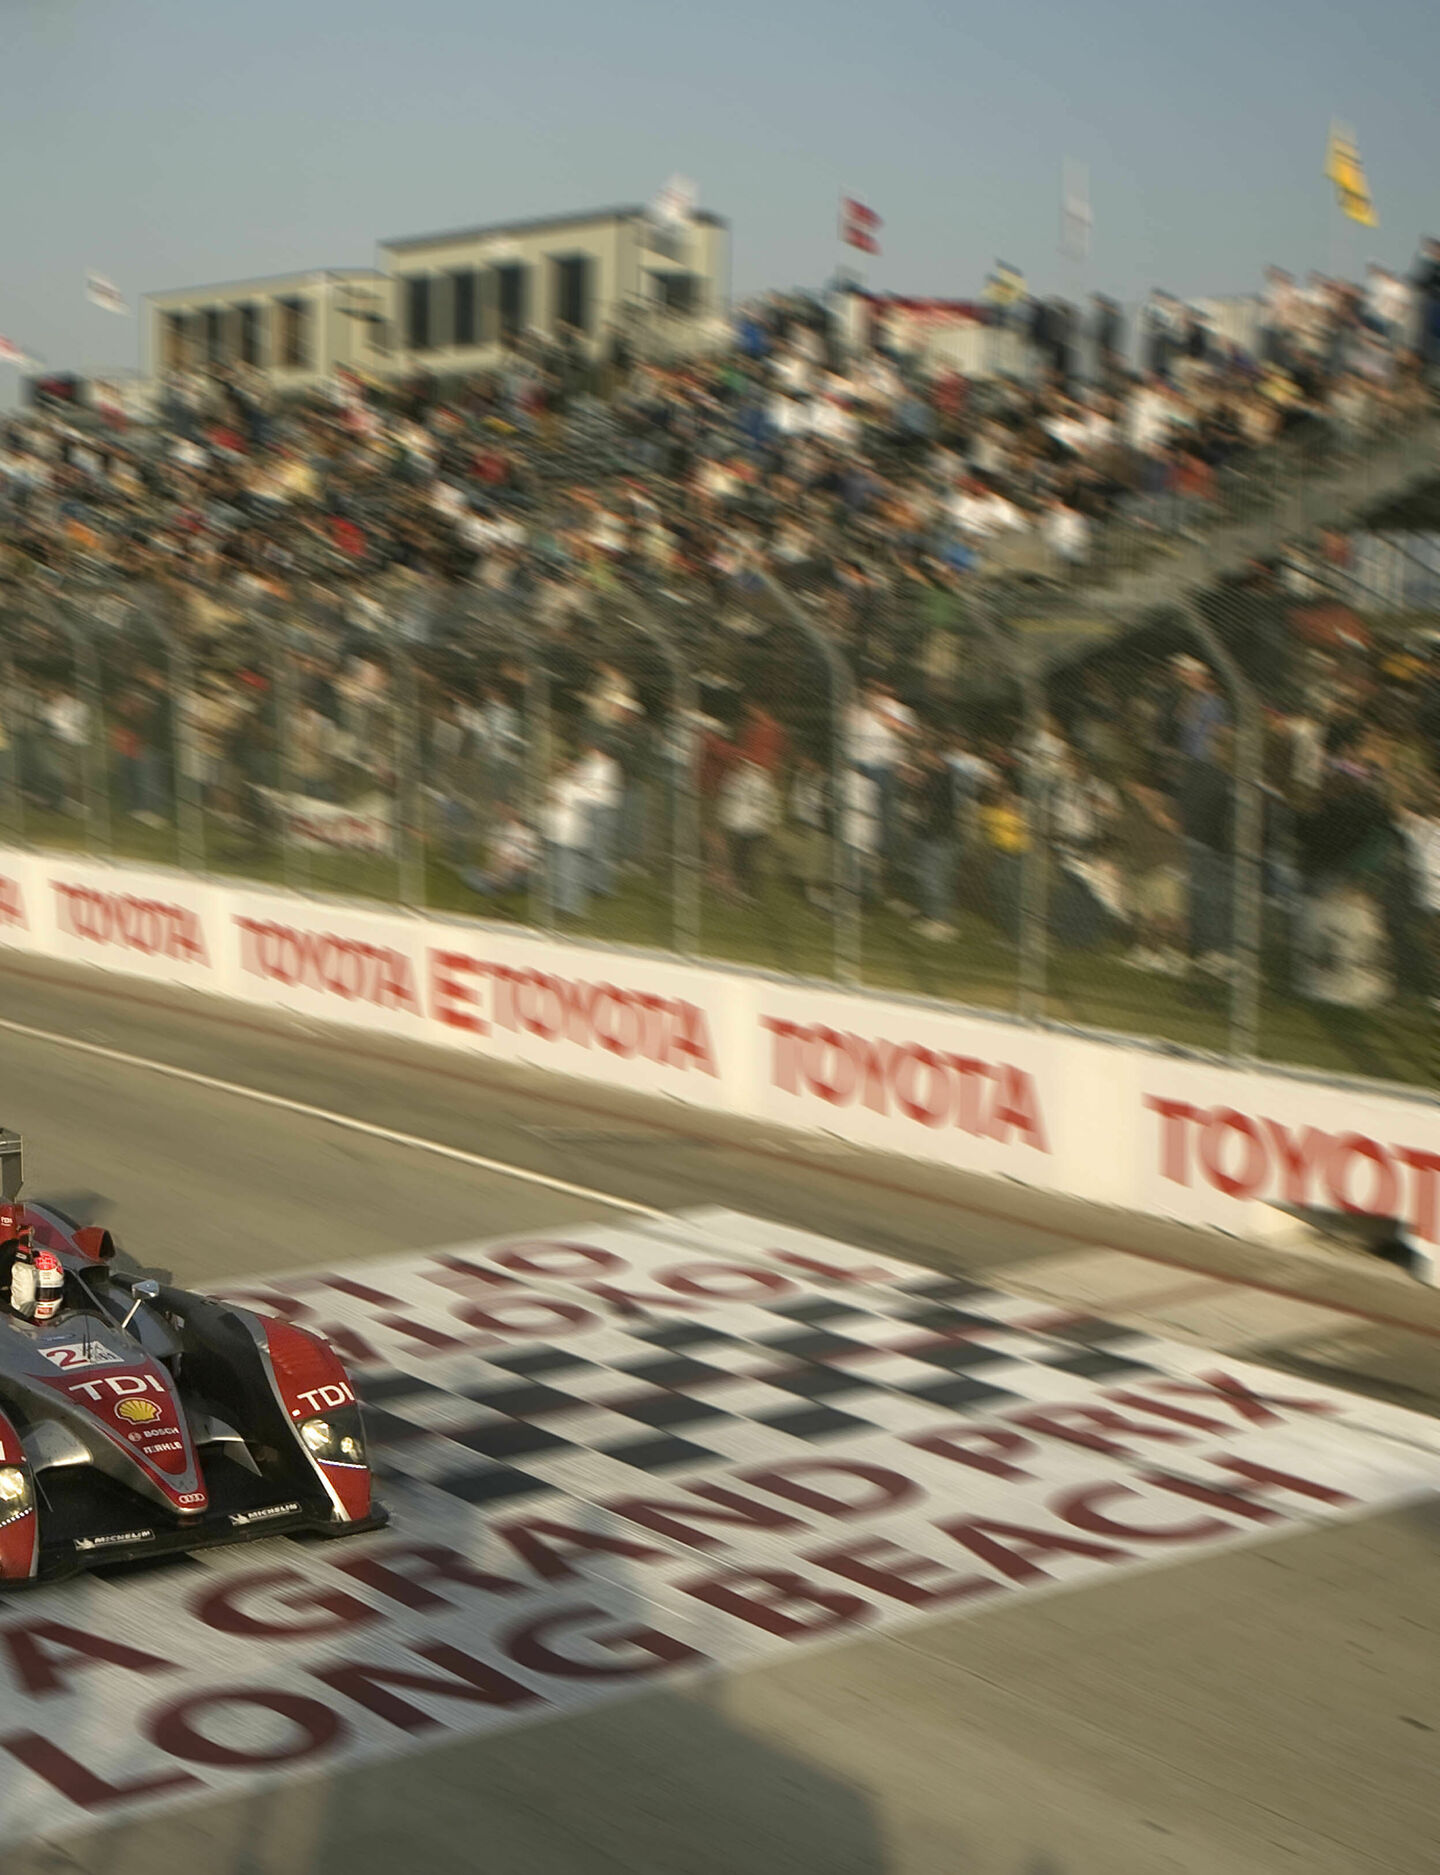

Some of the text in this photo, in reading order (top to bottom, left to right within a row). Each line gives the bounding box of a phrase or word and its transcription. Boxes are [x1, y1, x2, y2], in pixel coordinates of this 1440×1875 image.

[49, 878, 213, 969] TOYOTA
[232, 914, 424, 1018] TOYOTA
[482, 960, 721, 1080] TOYOTA
[758, 1013, 1053, 1155] TOYOTA
[1140, 1092, 1440, 1246] TOYOT
[47, 1349, 88, 1367] 2
[68, 1374, 165, 1401] TDI
[296, 1382, 355, 1411] TDI
[143, 1426, 180, 1438] BOSCH
[191, 1456, 928, 1643] GRAND
[895, 1369, 1343, 1482] PRIX
[247, 1502, 298, 1519] MICHELIN
[665, 1451, 1363, 1642] BEACH
